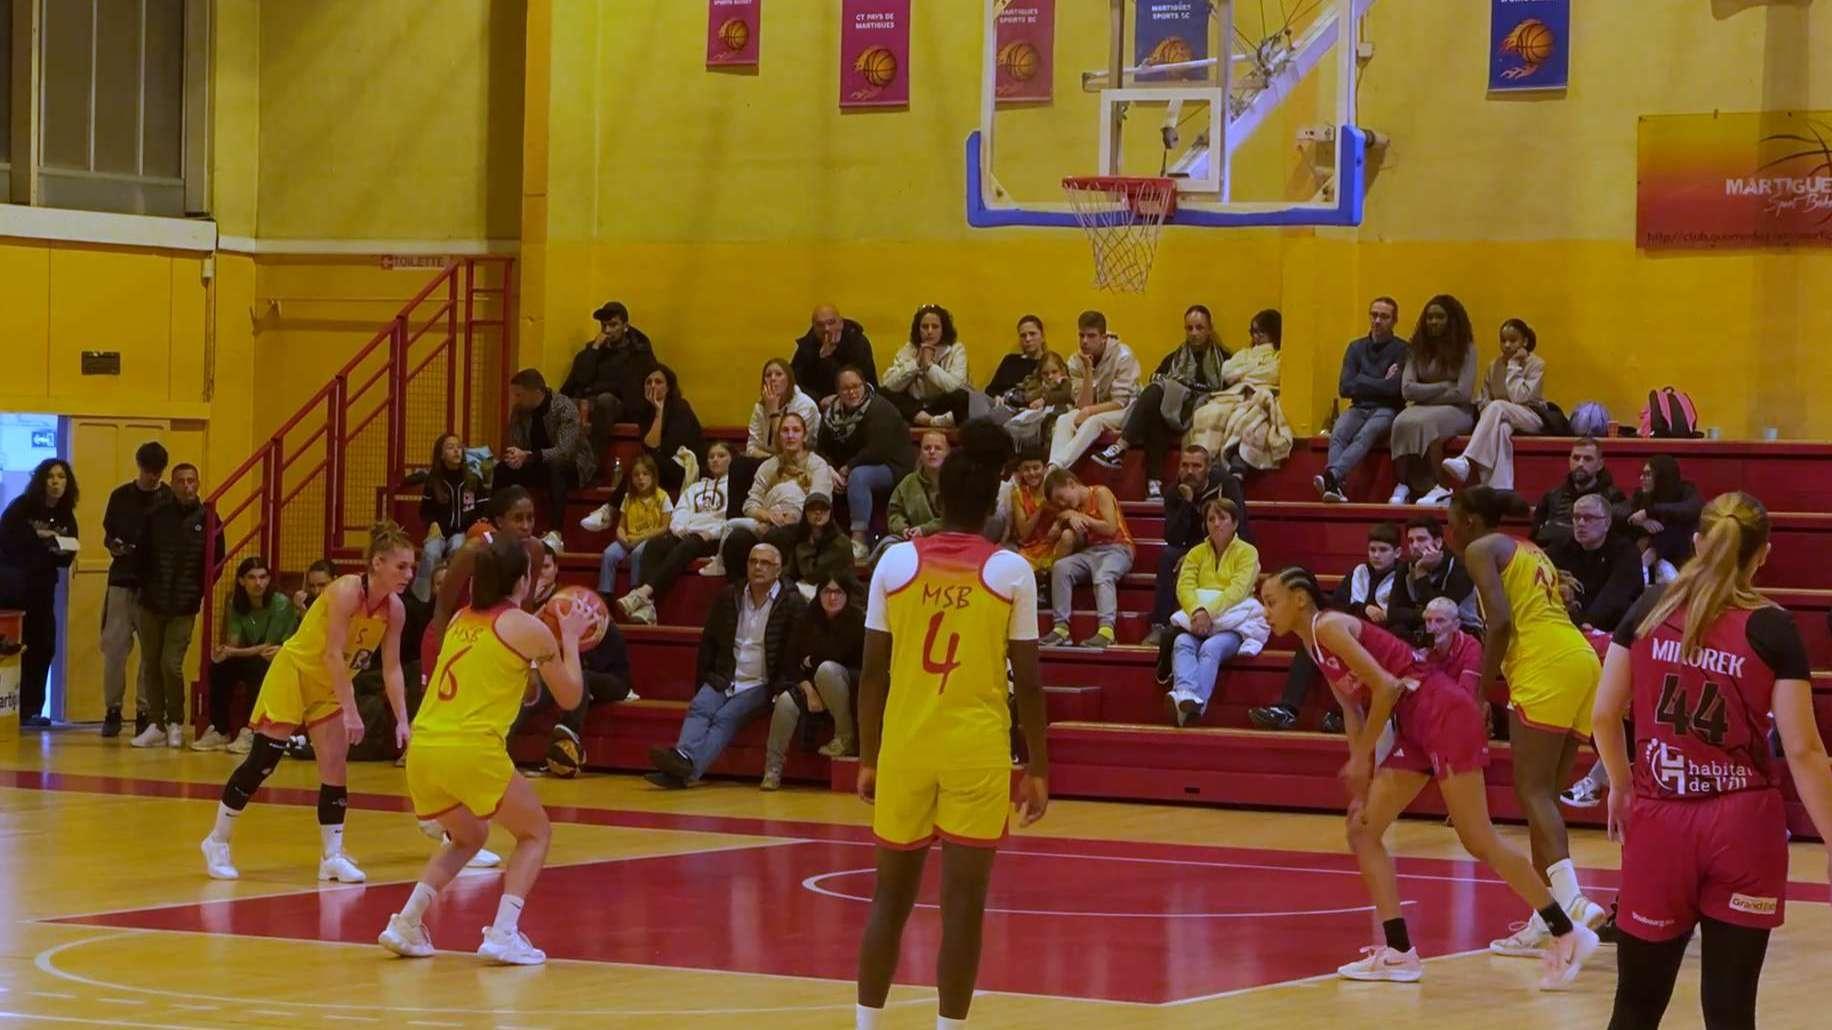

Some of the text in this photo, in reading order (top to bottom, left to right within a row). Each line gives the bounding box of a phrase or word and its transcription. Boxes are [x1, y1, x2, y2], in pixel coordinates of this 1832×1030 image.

[922, 583, 972, 609] MSB
[356, 628, 368, 644] 5
[922, 611, 961, 695] 4
[438, 645, 473, 701] 6
[1655, 673, 1728, 744] 44
[1689, 776, 1710, 792] de
